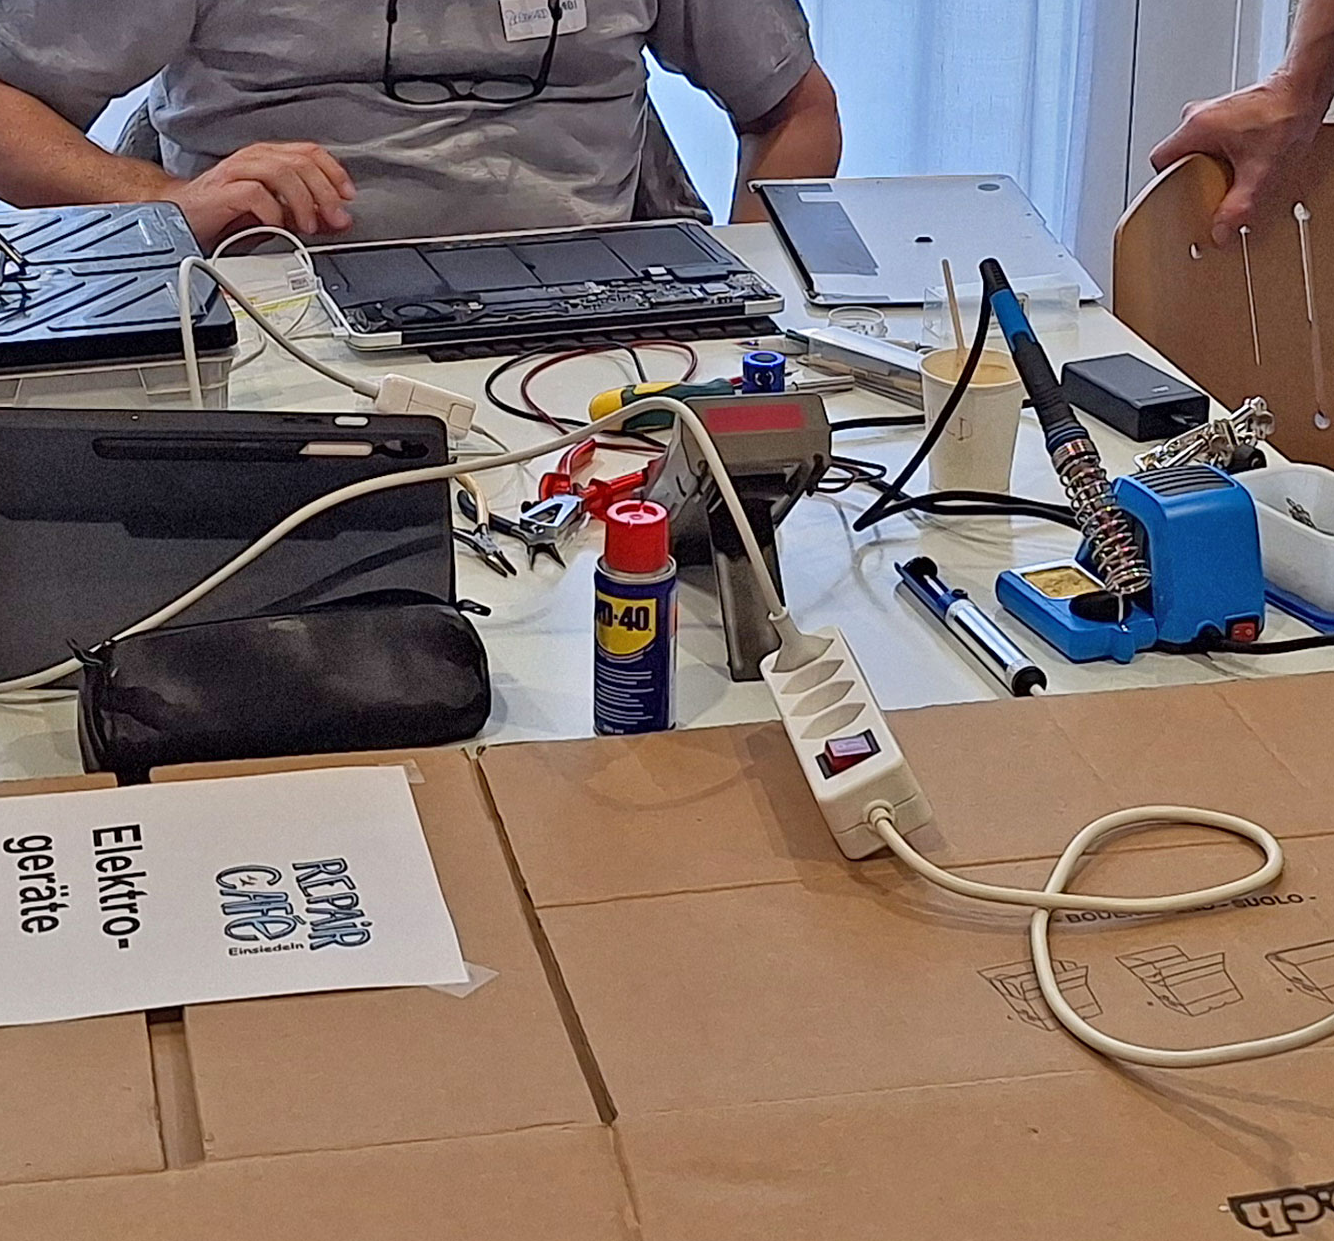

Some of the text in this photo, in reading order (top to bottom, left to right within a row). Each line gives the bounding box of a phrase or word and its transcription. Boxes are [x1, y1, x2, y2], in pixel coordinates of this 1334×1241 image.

[2, 834, 70, 934] geräte
[92, 824, 149, 950] Elektro-
[228, 942, 305, 957] Einsiedeln
